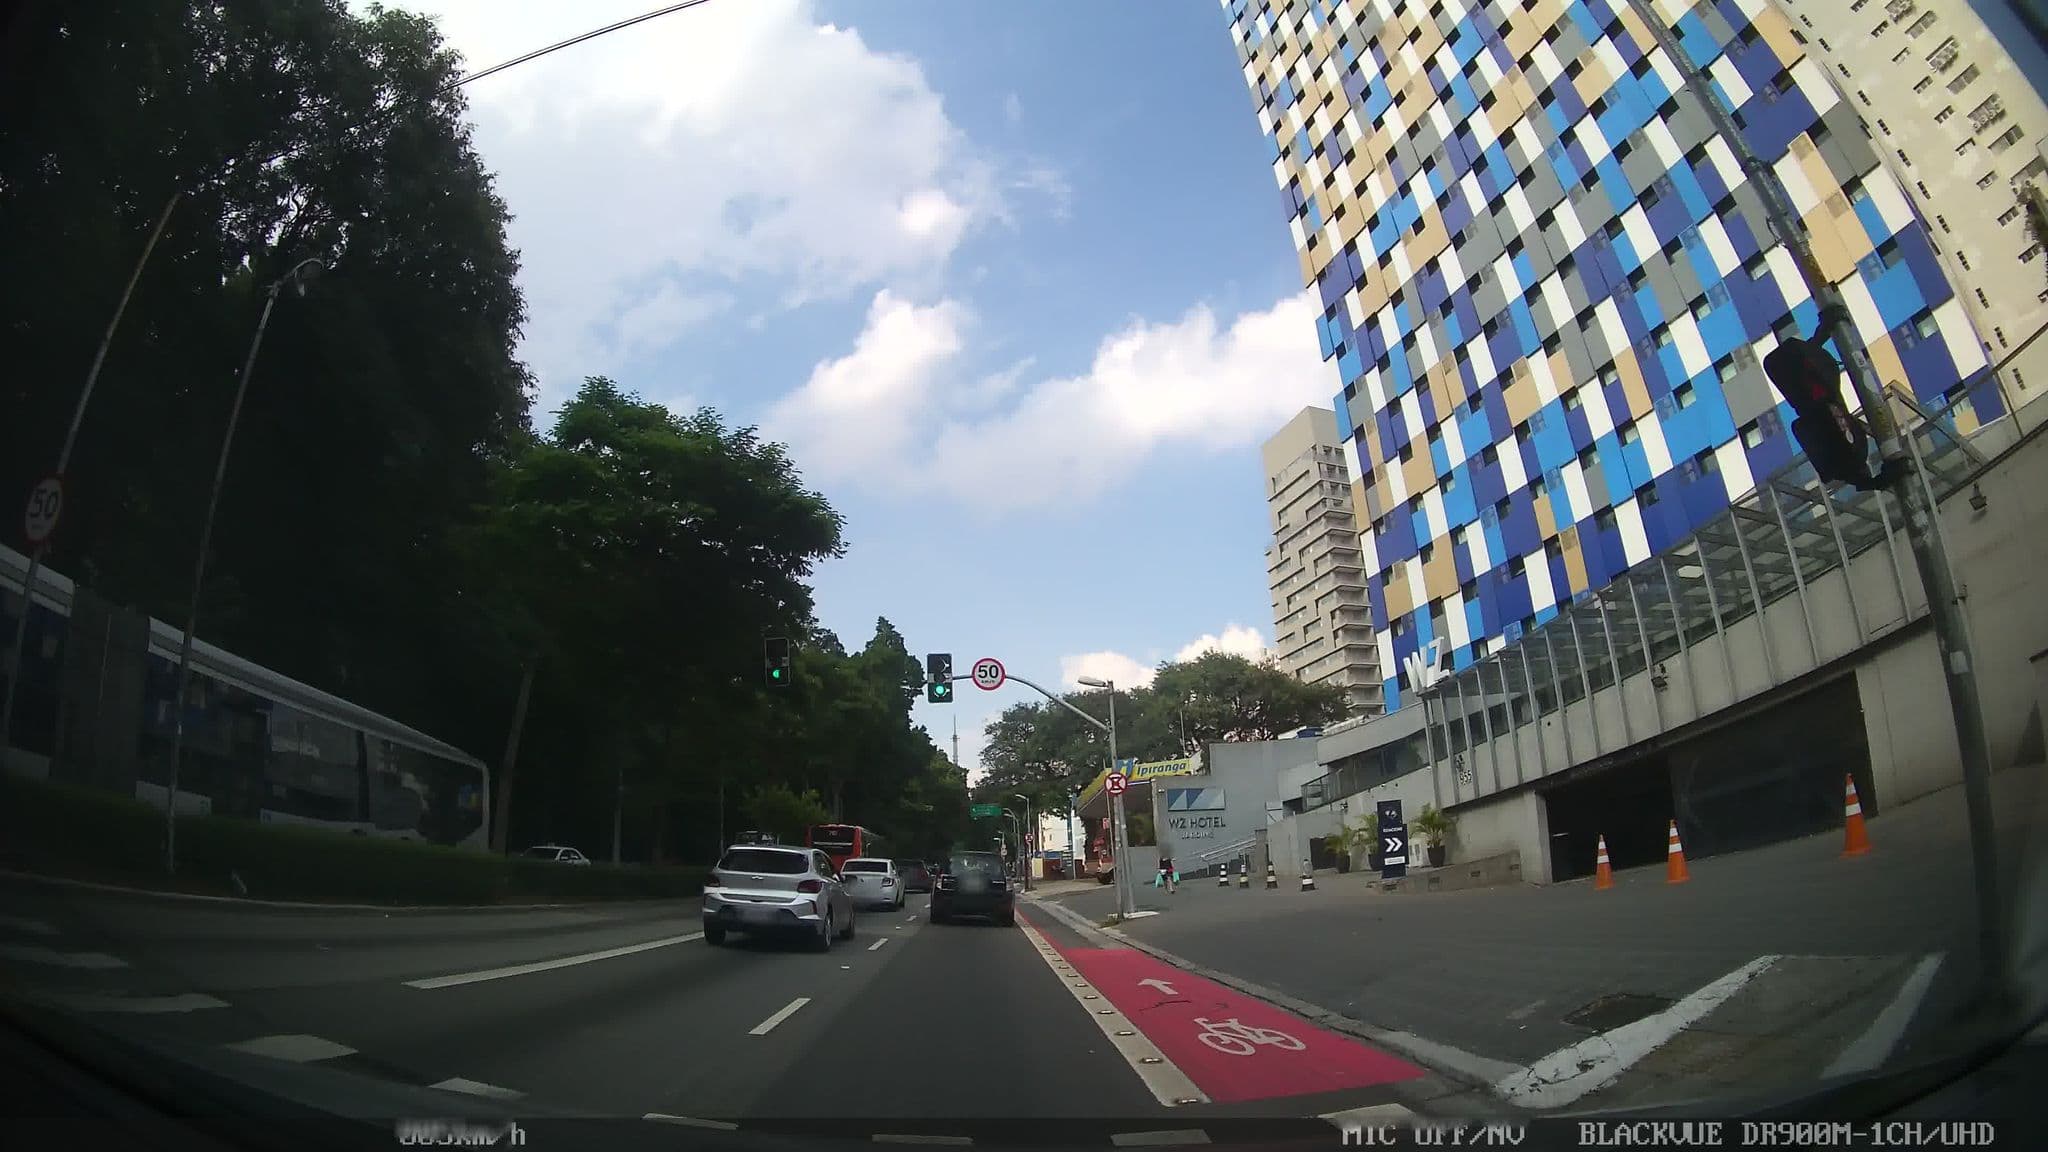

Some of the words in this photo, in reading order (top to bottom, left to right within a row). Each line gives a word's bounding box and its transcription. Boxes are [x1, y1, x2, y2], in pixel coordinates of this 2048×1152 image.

[30, 488, 60, 519] 50
[978, 665, 999, 679] 50
[1403, 637, 1450, 693] WZ
[1137, 763, 1187, 776] Ipiranga
[1169, 818, 1186, 828] WZ
[1190, 816, 1226, 828] HOTEL
